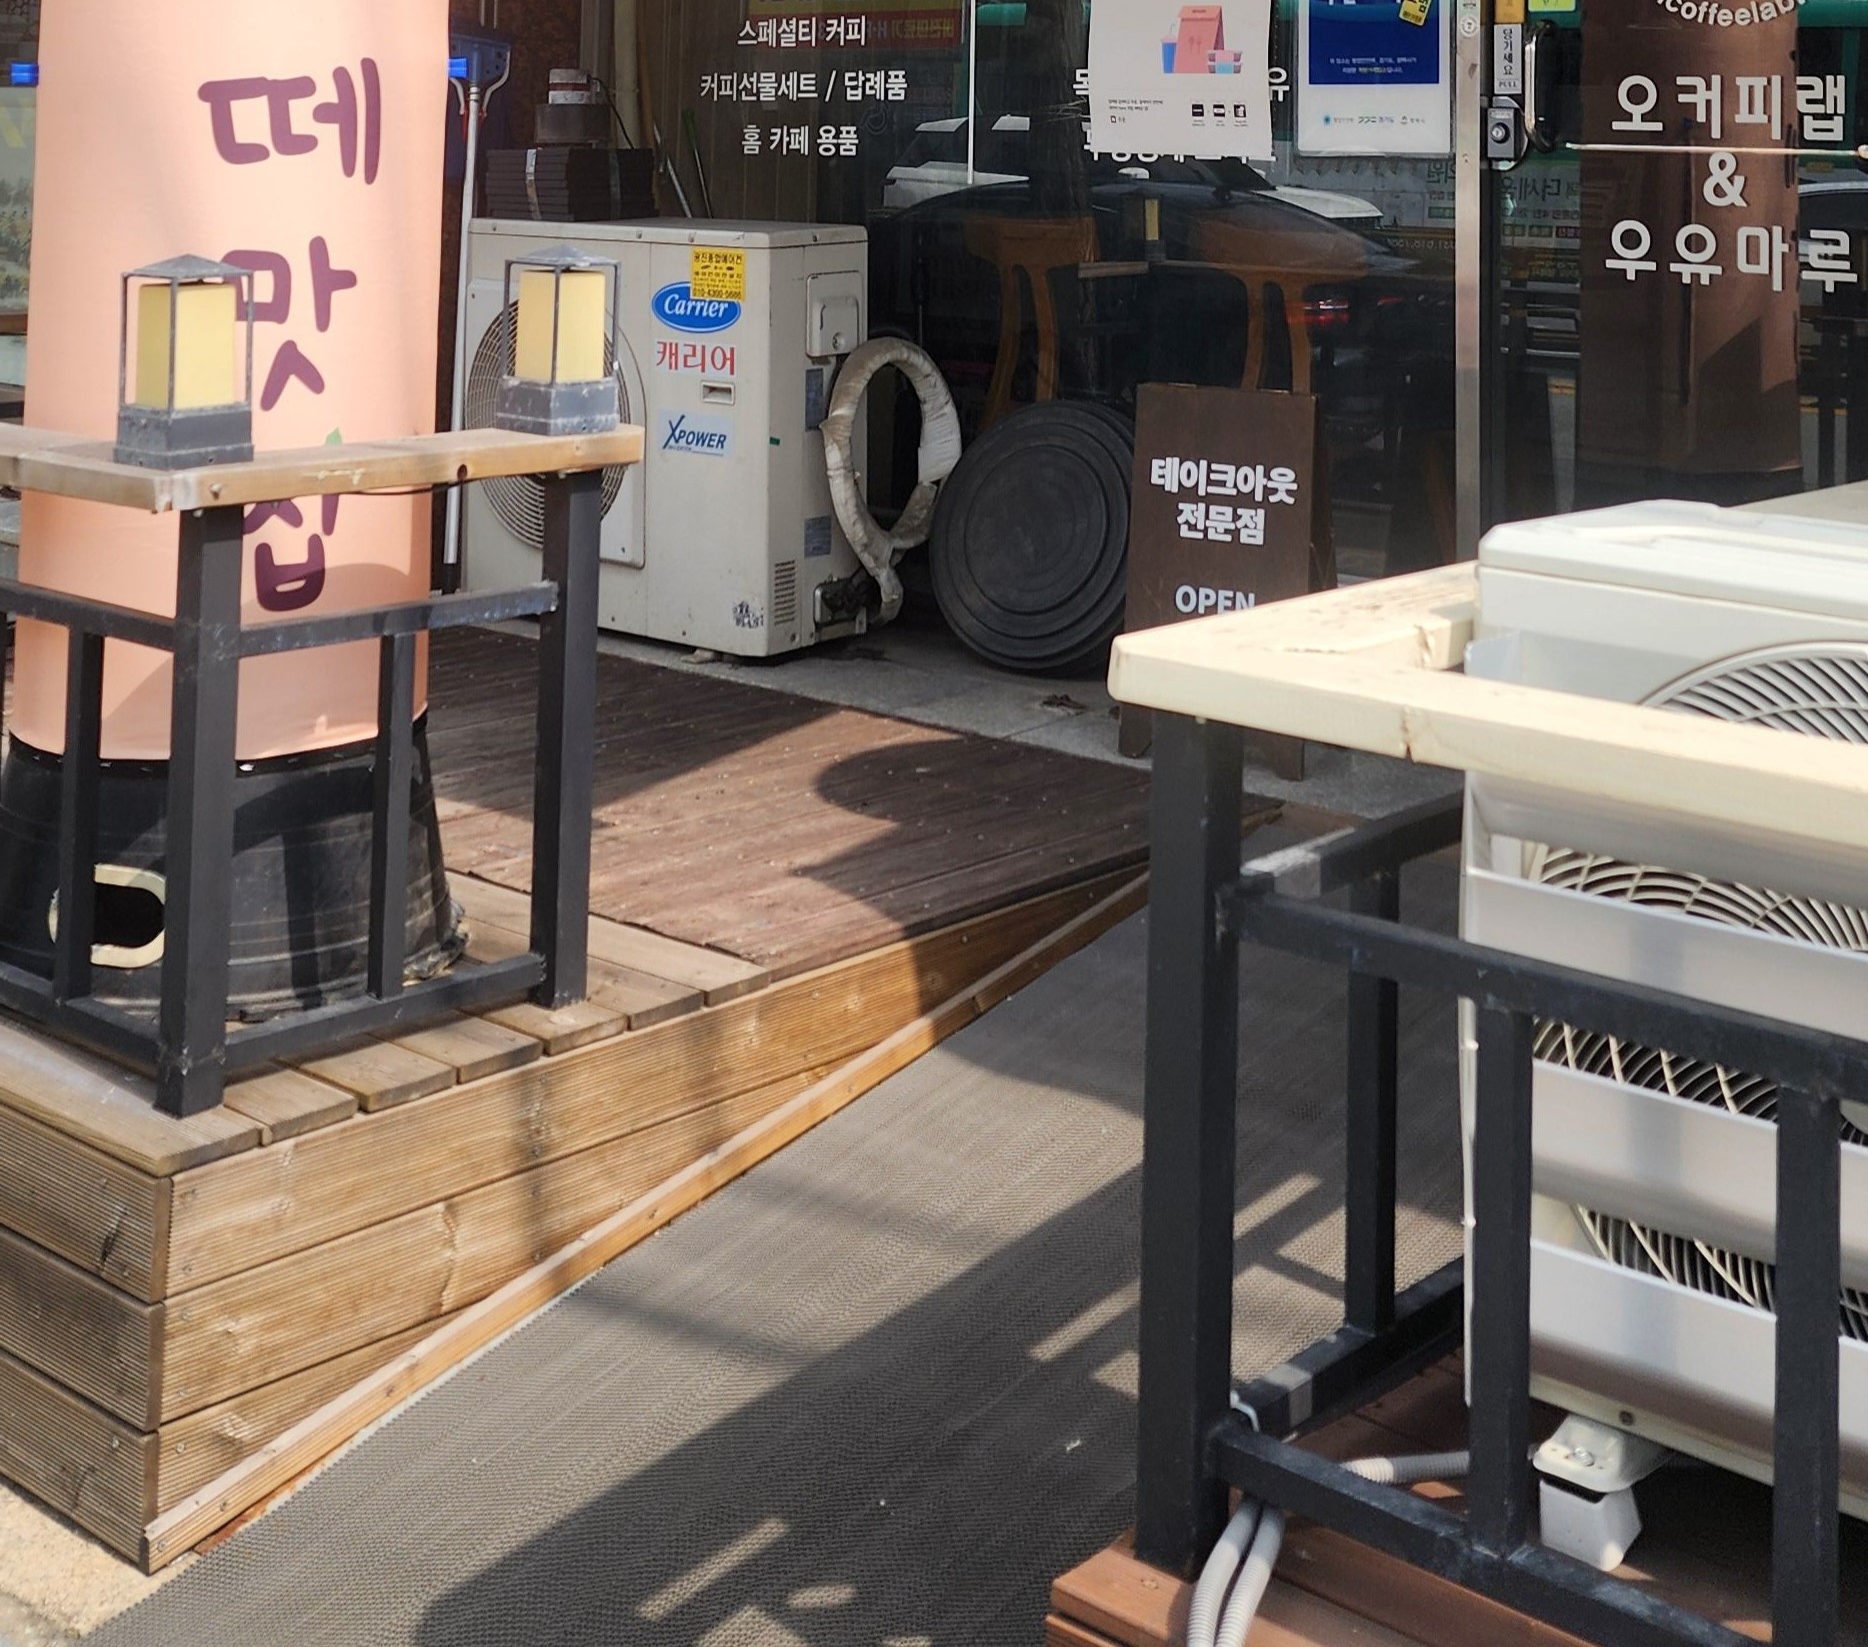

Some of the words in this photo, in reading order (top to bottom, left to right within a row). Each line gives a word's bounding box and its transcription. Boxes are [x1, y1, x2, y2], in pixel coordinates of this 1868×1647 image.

[737, 17, 817, 49] 스페셜티
[825, 15, 867, 47] 커피
[700, 71, 819, 103] 커피선물세트
[843, 69, 908, 102] 답례품
[1611, 73, 1847, 142] 오커피랩
[741, 124, 763, 156] 홈
[769, 124, 809, 156] 카페
[816, 124, 859, 157] 용품
[1703, 152, 1748, 208] &
[1605, 219, 1859, 294] 우유마루
[663, 293, 730, 319] Carrier
[656, 340, 737, 377] 캐리어
[663, 414, 727, 450] XPOWER
[1150, 456, 1298, 504] 테이크아웃
[1176, 502, 1266, 546] 전문점
[1175, 584, 1255, 615] OPEN
